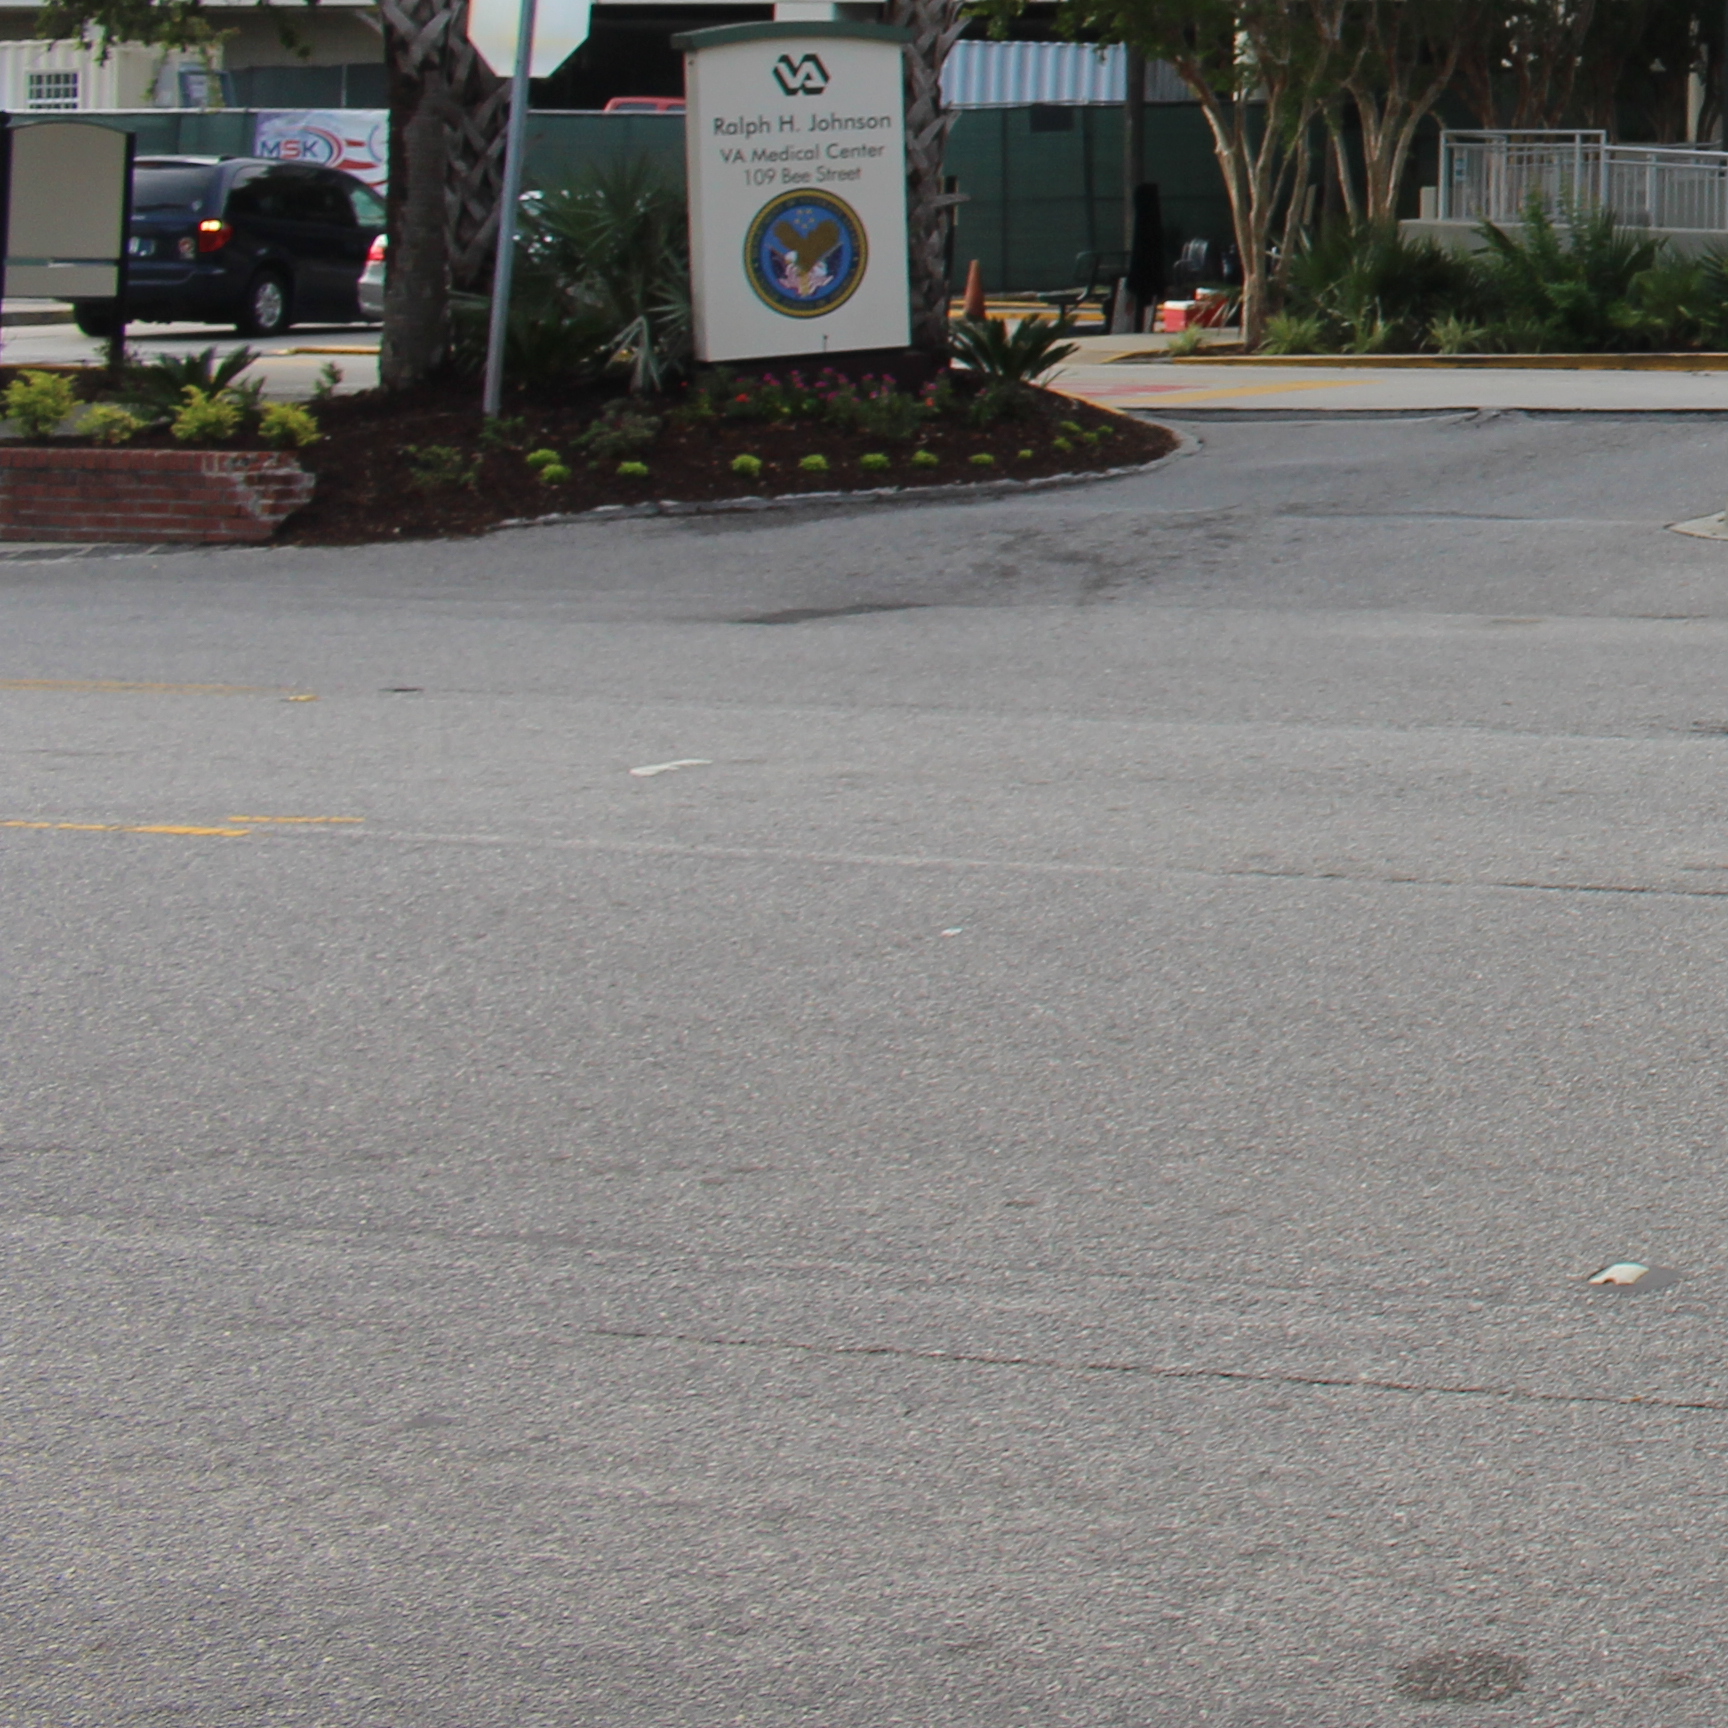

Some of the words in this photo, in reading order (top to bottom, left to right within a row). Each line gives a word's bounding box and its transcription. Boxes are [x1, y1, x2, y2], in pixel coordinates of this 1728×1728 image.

[772, 53, 831, 96] VA
[713, 115, 770, 139] Ralph
[778, 115, 800, 132] H.
[808, 112, 891, 132] Johnson
[260, 140, 319, 160] MSK
[720, 148, 746, 163] VA
[751, 144, 820, 162] Medical
[825, 143, 884, 159] Center
[744, 168, 776, 185] 109
[781, 168, 811, 184] Bee
[816, 165, 861, 182] Street
